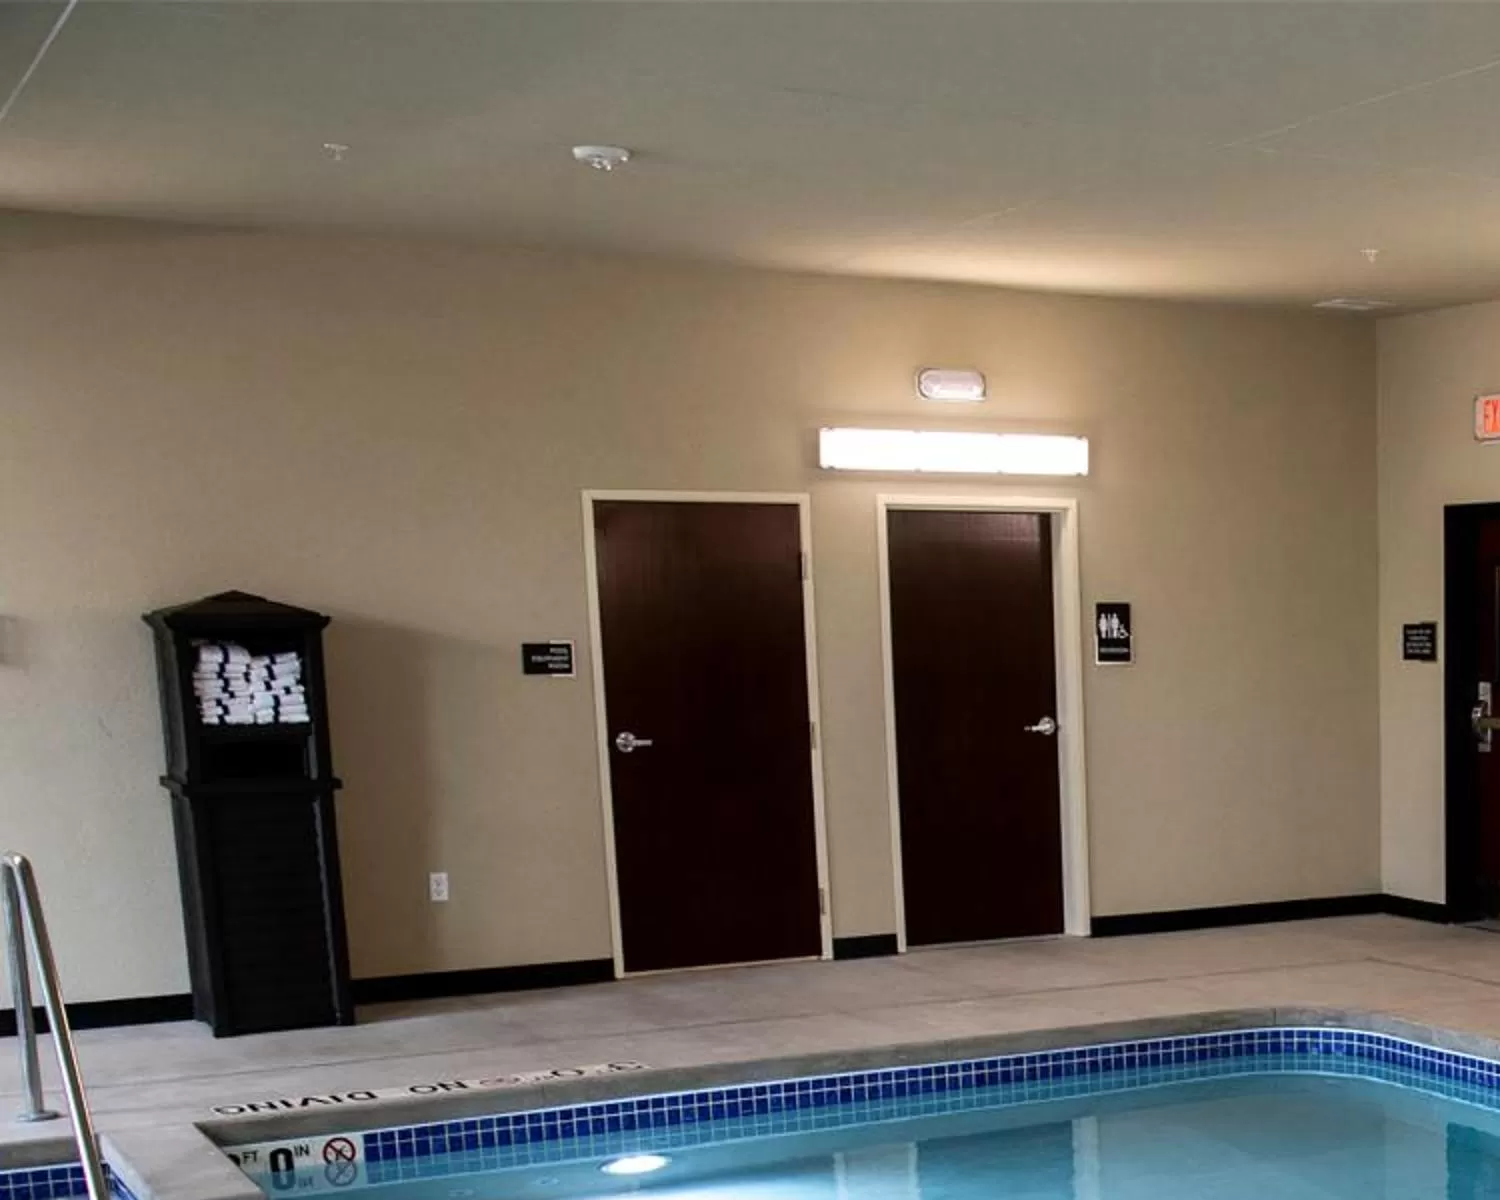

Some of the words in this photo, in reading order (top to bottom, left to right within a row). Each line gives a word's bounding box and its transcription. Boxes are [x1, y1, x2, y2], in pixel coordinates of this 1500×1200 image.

[409, 1080, 468, 1094] NO
[213, 1090, 379, 1115] DIVING
[241, 1150, 258, 1164] FT
[294, 1144, 310, 1157] IN
